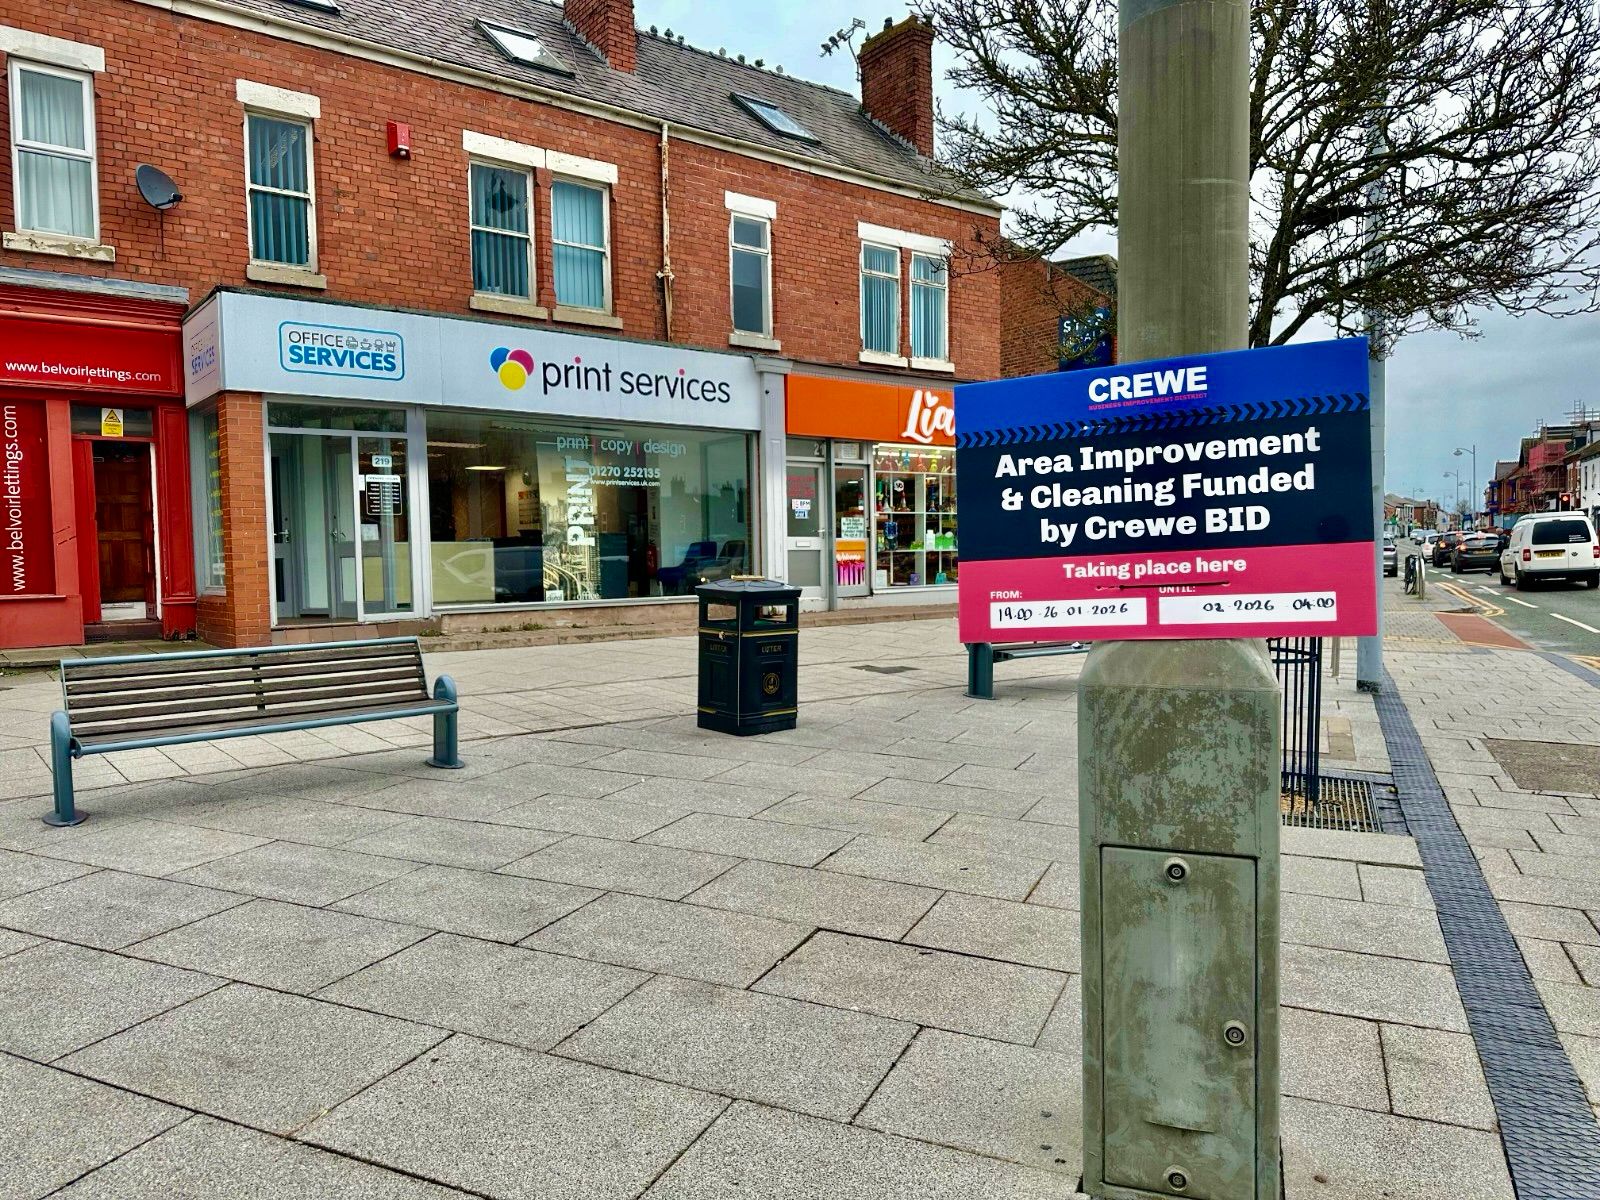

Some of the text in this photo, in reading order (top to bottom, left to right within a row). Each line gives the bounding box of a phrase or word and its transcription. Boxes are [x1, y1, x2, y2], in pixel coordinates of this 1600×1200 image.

[289, 331, 344, 348] OFFICE
[288, 345, 397, 372] SERVICES
[5, 362, 161, 382] www.belvoirlettings.com
[542, 356, 730, 403] print services
[1088, 366, 1208, 402] CREWE
[1088, 393, 1208, 411] BUSINESS IMPROVEMENT DISTRICT
[556, 435, 687, 457] print copy design
[995, 427, 1321, 478] Area Improvement
[589, 466, 661, 478] 01270 252135
[1001, 462, 1315, 511] & Cleaning Funded
[3, 405, 26, 592] www.belvoirlettings.com
[1041, 505, 1271, 547] by Crewe BID
[1063, 556, 1247, 579] Taking place here
[990, 590, 1023, 599] FROM:
[1044, 605, 1058, 618] 26
[1091, 603, 1129, 615] 2026
[1203, 602, 1224, 613] 02
[1233, 600, 1275, 611] 2026
